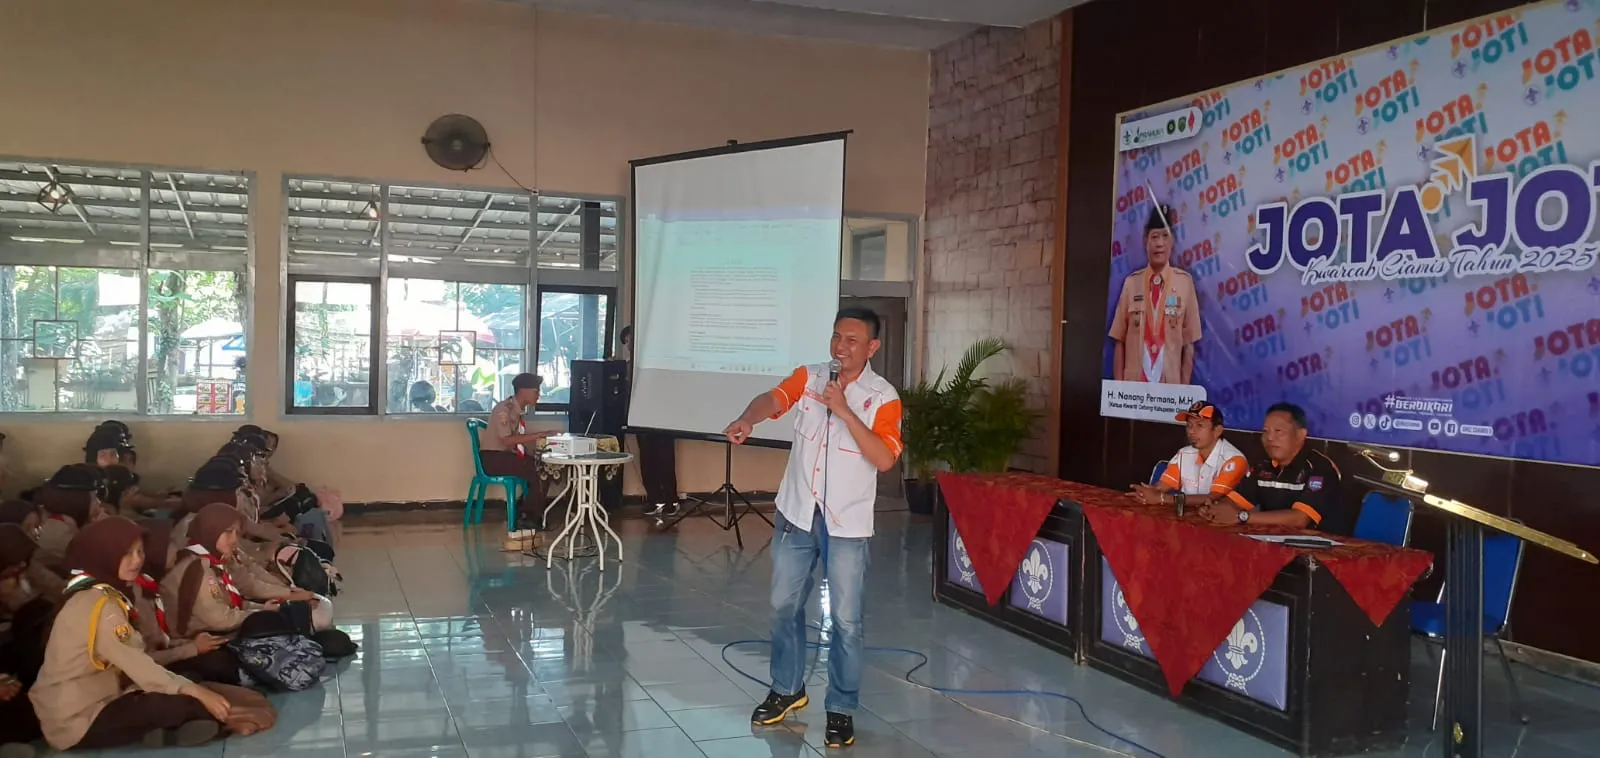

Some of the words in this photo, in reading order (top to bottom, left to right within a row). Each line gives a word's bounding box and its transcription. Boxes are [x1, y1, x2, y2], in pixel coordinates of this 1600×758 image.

[1472, 22, 1528, 72] JOTI
[1522, 28, 1592, 84] JOTA
[1300, 59, 1346, 96] JOTA
[1315, 68, 1357, 111] JOTI
[1545, 48, 1600, 98] JOT
[1355, 69, 1407, 116] JOTA
[1372, 86, 1419, 129] JOTI
[1203, 97, 1230, 127] OTI
[1222, 108, 1262, 148] JOTA
[1416, 94, 1474, 143] JOTA
[1235, 123, 1271, 160] JOTI
[1273, 123, 1319, 165] JOTA
[1288, 139, 1329, 176] JOTI
[1484, 120, 1551, 172] JOTA
[1165, 149, 1201, 185] JOTA
[1177, 163, 1209, 193] JOTI
[1325, 149, 1375, 192] JOTA
[1116, 185, 1145, 212] OTA
[1199, 173, 1237, 210] JOTA
[1212, 188, 1246, 219] JOTI
[1247, 188, 1440, 272] JOTA
[1455, 165, 1600, 251] JO
[1192, 253, 1220, 281] OTI
[1305, 257, 1376, 282] Kwarcab
[1381, 252, 1446, 277] Ciamis
[1451, 247, 1514, 275] Tahun
[1519, 247, 1598, 269] 2025
[1217, 271, 1260, 302] JOTA
[1232, 284, 1268, 312] JOTI
[1301, 280, 1349, 318] JOTA
[1464, 273, 1529, 317] JOTA
[1234, 314, 1276, 346] JOTA
[1317, 299, 1359, 331] JOTI
[1486, 294, 1544, 330] JOTI
[1366, 315, 1419, 353] JOTA
[1383, 335, 1432, 368] JOTI
[1534, 318, 1600, 360] JOTA
[1277, 353, 1322, 383] JOTA
[1432, 355, 1491, 389] JOTA
[1107, 390, 1116, 400] H.
[1118, 391, 1145, 404] Nanang
[1146, 393, 1177, 406] Permana,
